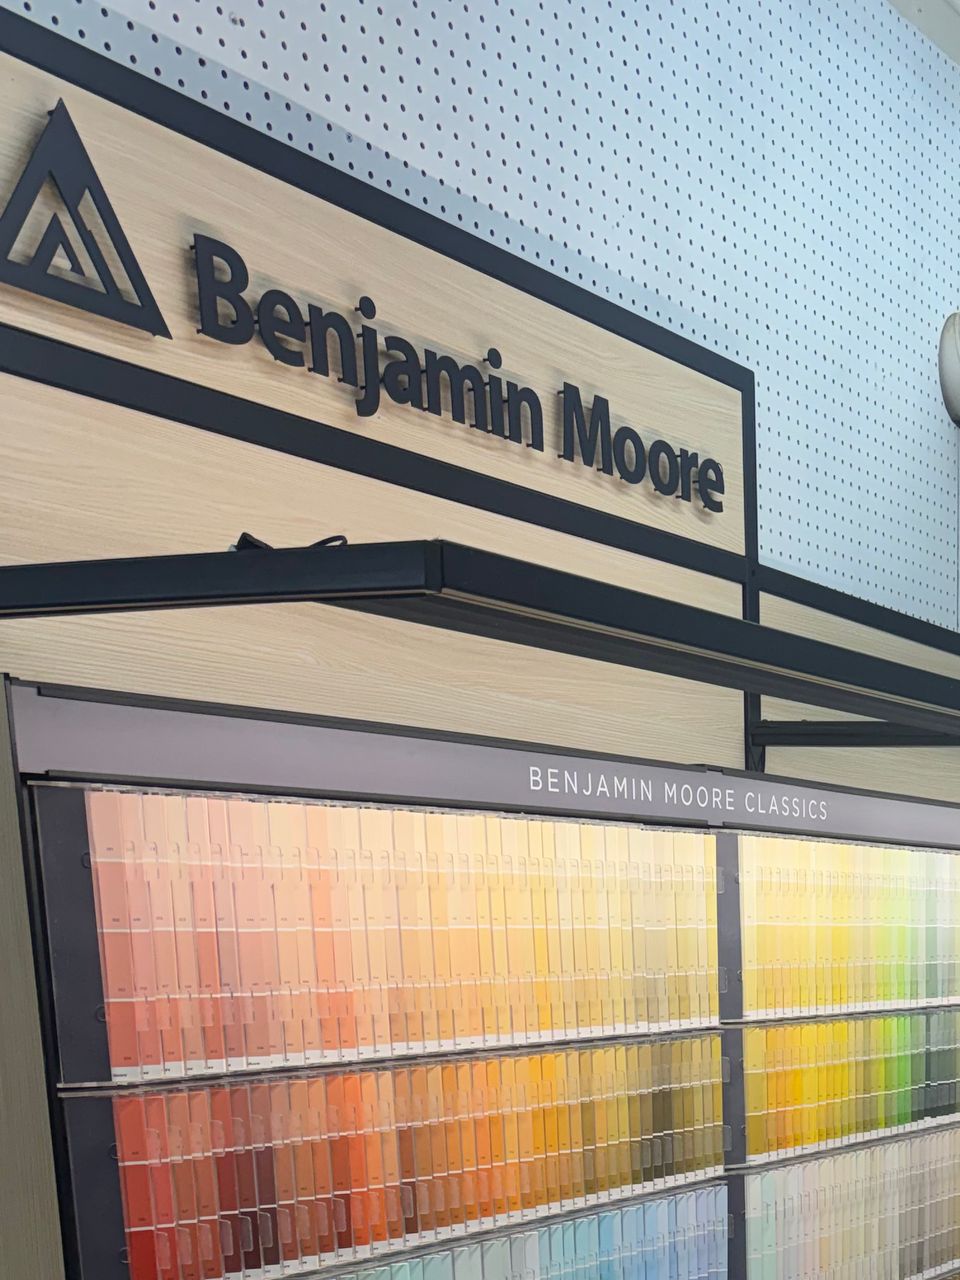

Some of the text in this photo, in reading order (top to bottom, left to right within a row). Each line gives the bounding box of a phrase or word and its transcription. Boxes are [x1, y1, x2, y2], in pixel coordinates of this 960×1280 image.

[193, 233, 725, 513] Benjamin Moore
[529, 766, 828, 820] BENJAMIN MOORE CLASSICS
